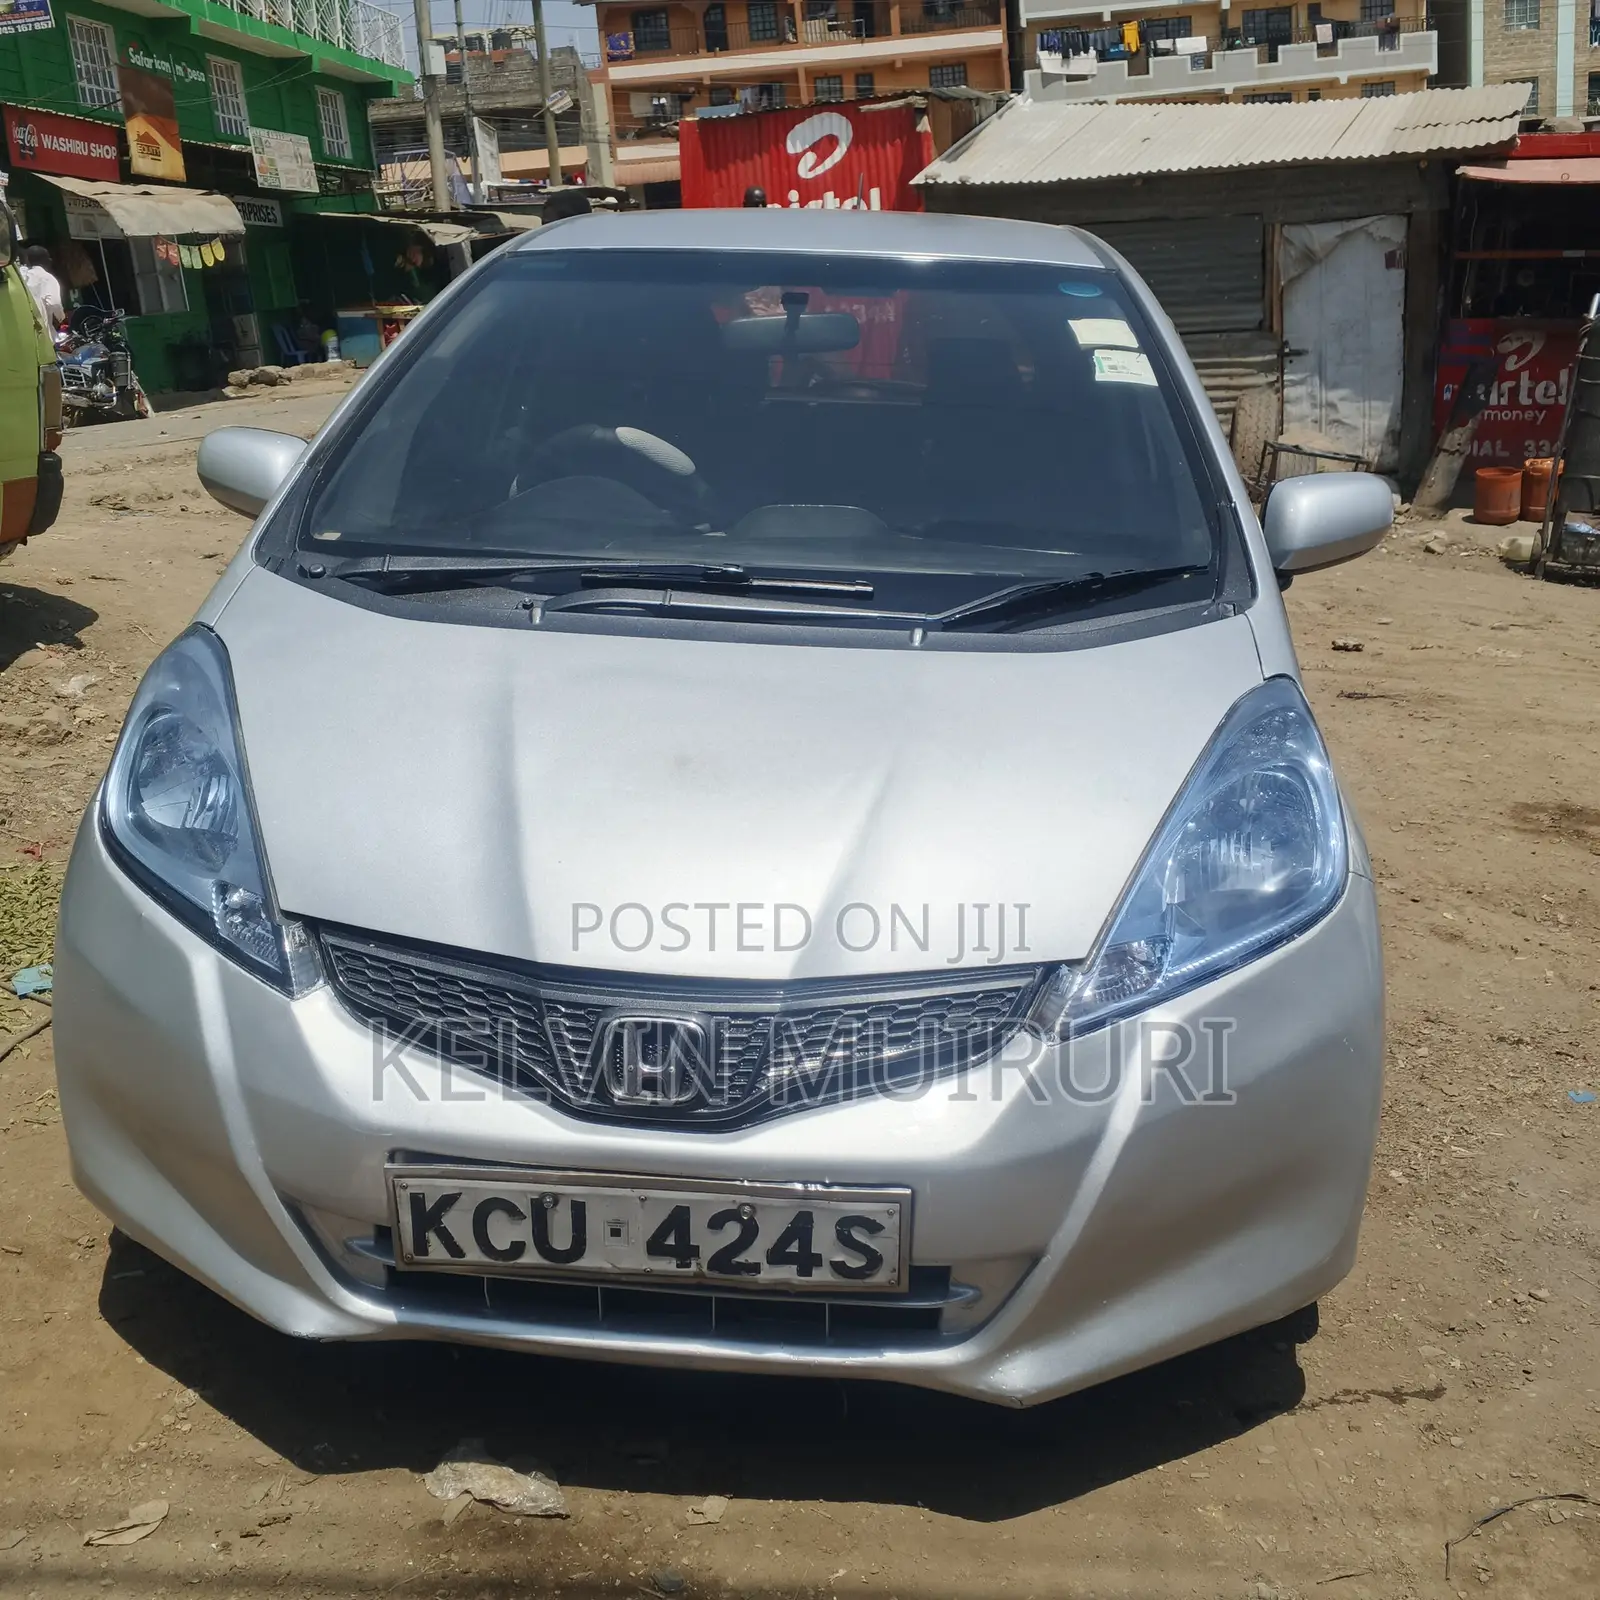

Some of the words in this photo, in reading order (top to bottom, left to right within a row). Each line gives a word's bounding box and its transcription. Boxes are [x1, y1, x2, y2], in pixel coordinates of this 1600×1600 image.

[16, 23, 32, 32] 167
[34, 20, 52, 30] 857
[41, 133, 88, 156] WASHIRU
[90, 142, 117, 159] SHOP
[1488, 368, 1570, 406] irtel
[1484, 409, 1547, 424] money
[408, 1191, 587, 1264] KCU
[645, 1204, 886, 1280] 424S
